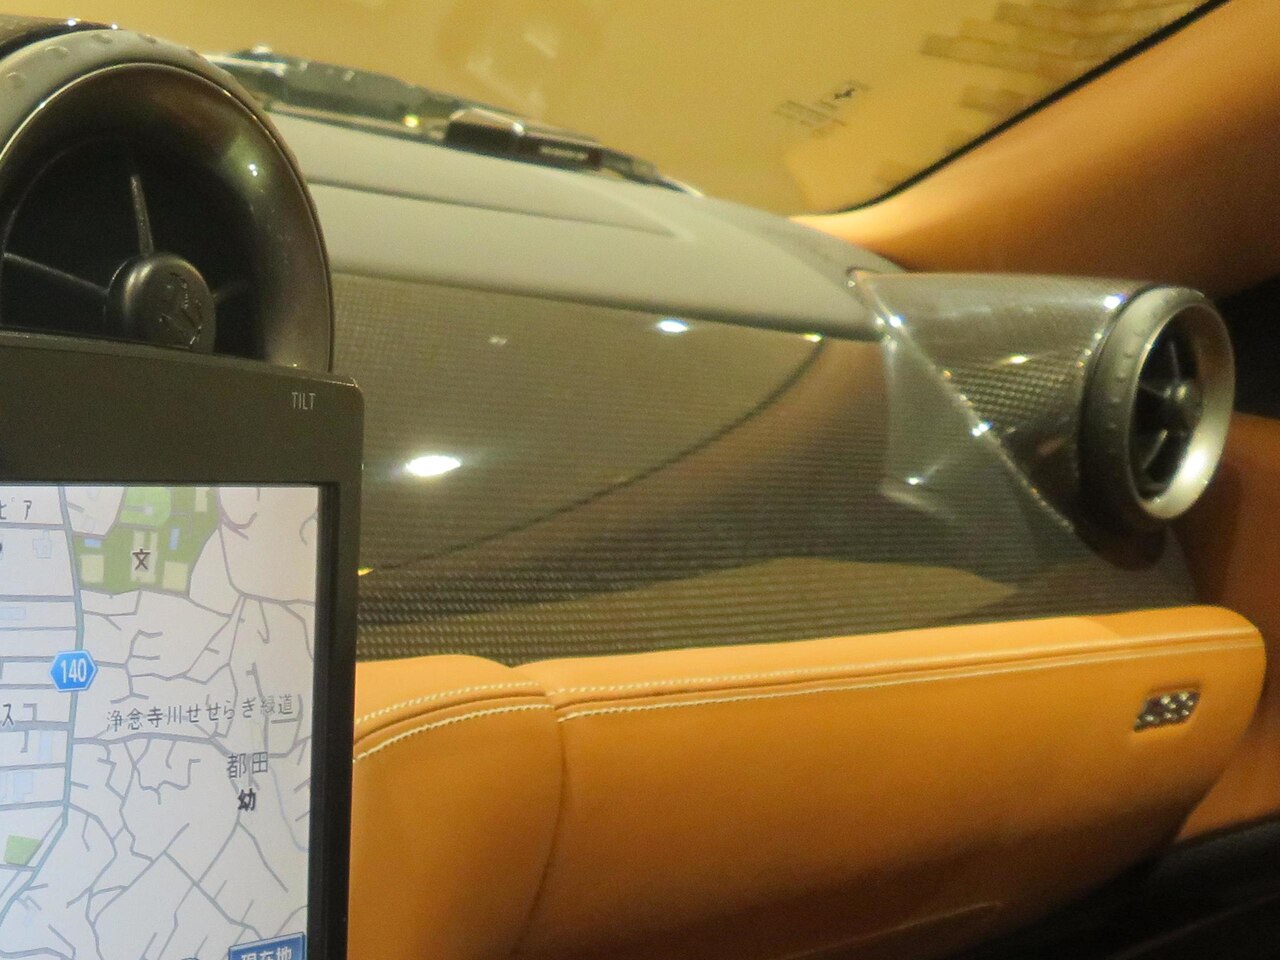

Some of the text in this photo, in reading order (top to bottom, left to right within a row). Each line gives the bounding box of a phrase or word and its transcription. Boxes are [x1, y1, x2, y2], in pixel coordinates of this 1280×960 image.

[291, 391, 316, 410] TILT
[59, 657, 87, 684] 140
[226, 751, 269, 779] 都田
